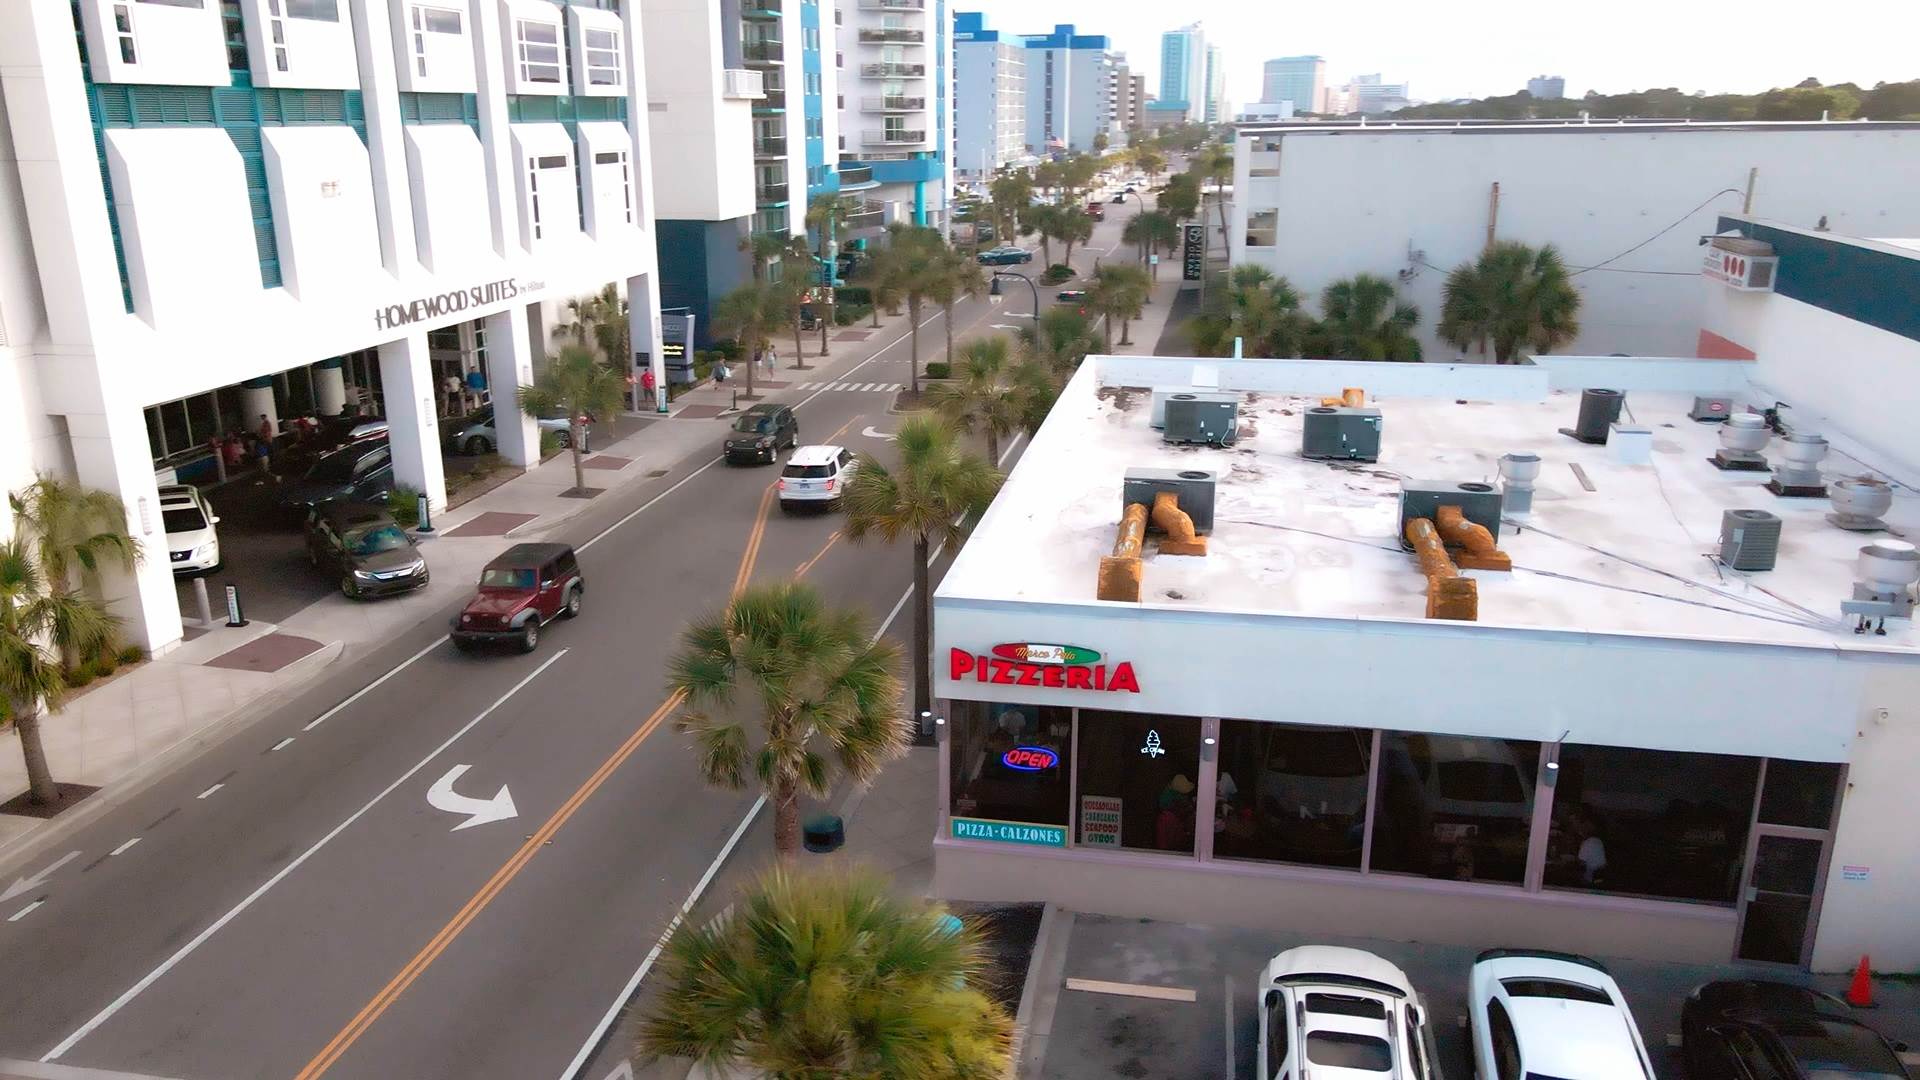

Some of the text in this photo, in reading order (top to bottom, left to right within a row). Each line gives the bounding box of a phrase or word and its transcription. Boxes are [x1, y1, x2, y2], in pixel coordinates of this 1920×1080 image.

[374, 289, 468, 331] HOMEWOOD
[471, 278, 518, 308] SUITES
[1015, 647, 1050, 659] Marco
[951, 646, 1140, 693] PIZZERIA
[1007, 749, 1053, 768] OPEN
[1084, 822, 1119, 833] SEAFOOD
[1087, 832, 1116, 844] GYROS
